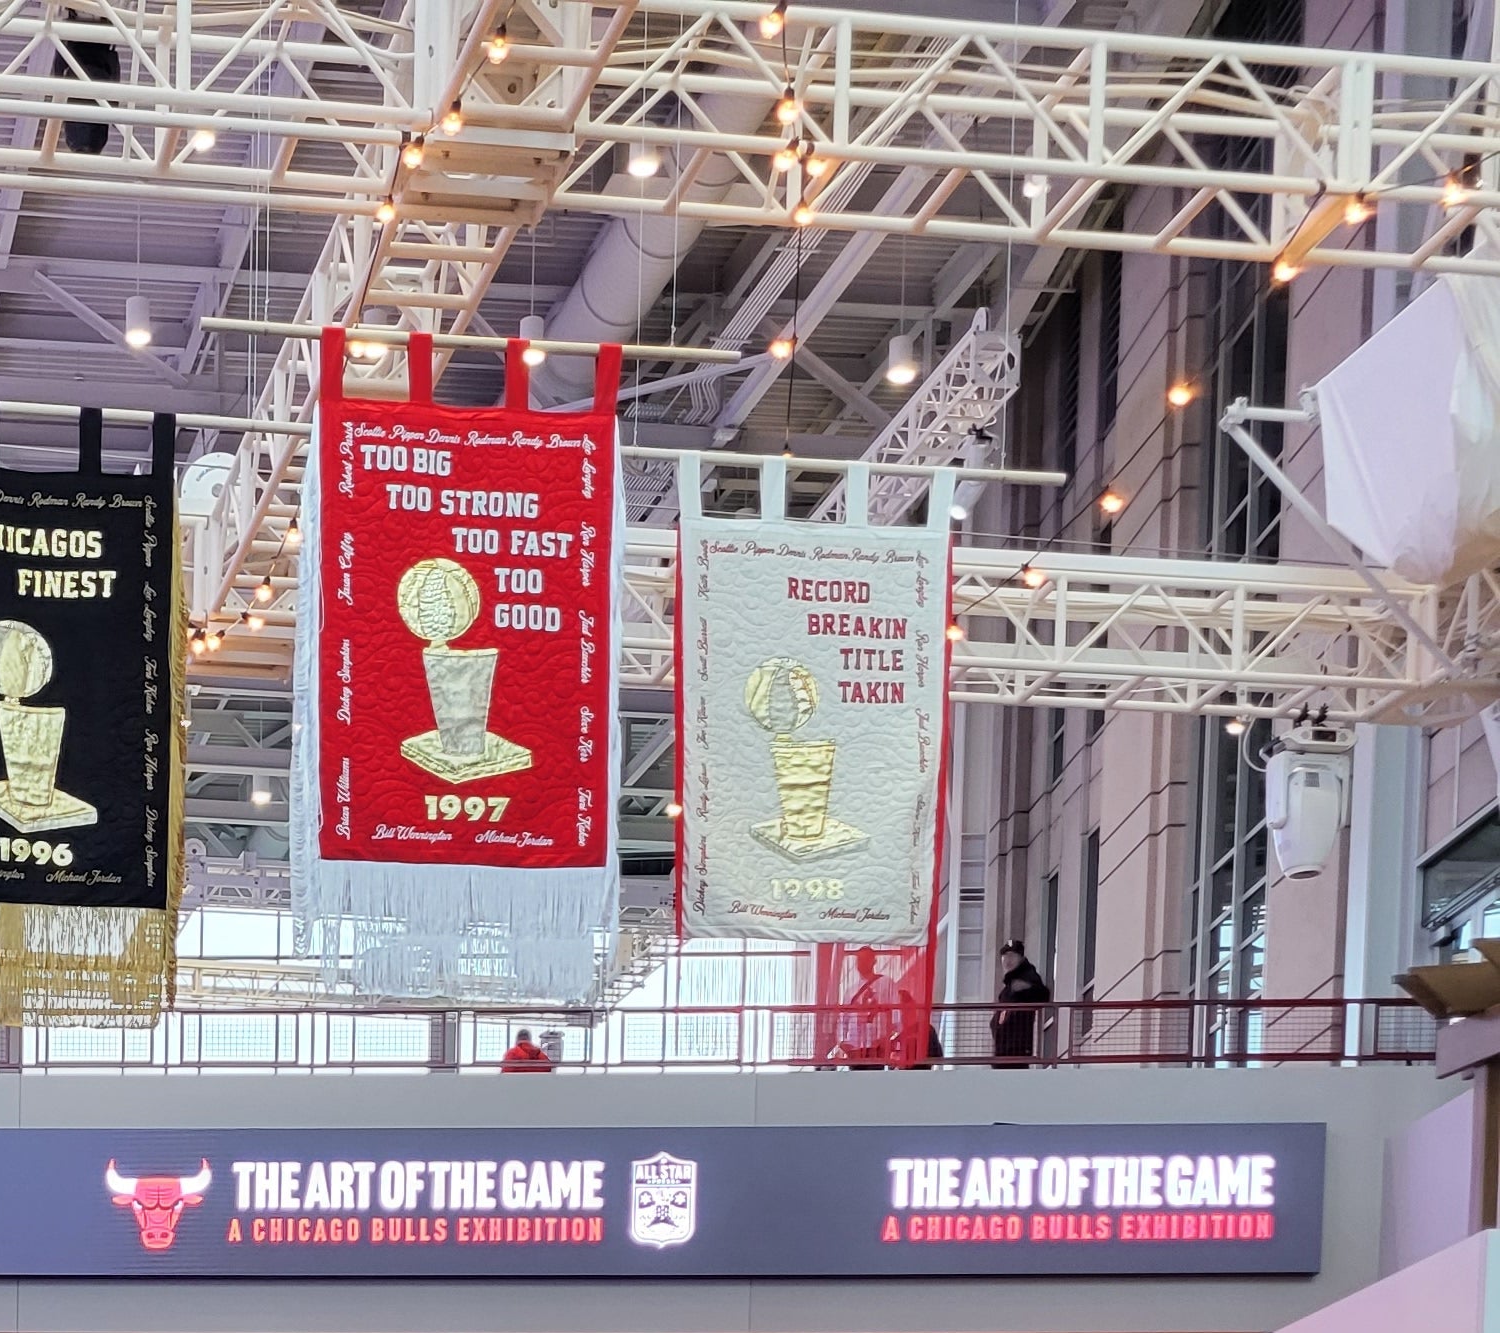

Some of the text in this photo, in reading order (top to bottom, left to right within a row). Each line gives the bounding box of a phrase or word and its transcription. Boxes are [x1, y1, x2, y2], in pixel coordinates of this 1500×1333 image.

[354, 423, 424, 442] Scottie Pippen
[425, 429, 507, 448] Dennis Rodman
[508, 431, 581, 449] Randy Brown
[360, 444, 451, 476] TOO BIG
[27, 492, 69, 507] Rodman
[72, 493, 142, 508] Randy Brown
[386, 484, 540, 519] TOO STRONG
[452, 527, 574, 558] TOO FAST
[18, 568, 117, 598] FINEST
[494, 567, 542, 594] TOO
[788, 577, 870, 604] RECORD
[495, 604, 560, 632] GOOD
[807, 613, 908, 640] BREAKIN
[840, 648, 904, 671] TITLE
[838, 681, 904, 704] TAKIN
[336, 758, 351, 840] Brian Williams
[424, 795, 510, 822] 1997
[372, 824, 453, 843] Bill Wennington
[475, 829, 554, 848] Michael Jordan
[46, 869, 121, 885] Michael Jordan
[770, 878, 844, 900] 1998
[819, 908, 890, 922] Michael Jordan
[232, 1161, 604, 1209] THE ART OF THE GAME
[636, 1165, 692, 1180] ALL STAR
[888, 1156, 1274, 1209] THE ART OF THE GAME
[228, 1218, 602, 1243] A CHICAGO BULLS EXHIBITION
[883, 1212, 1273, 1241] A CHICAGO BULLS EXHIBITION
